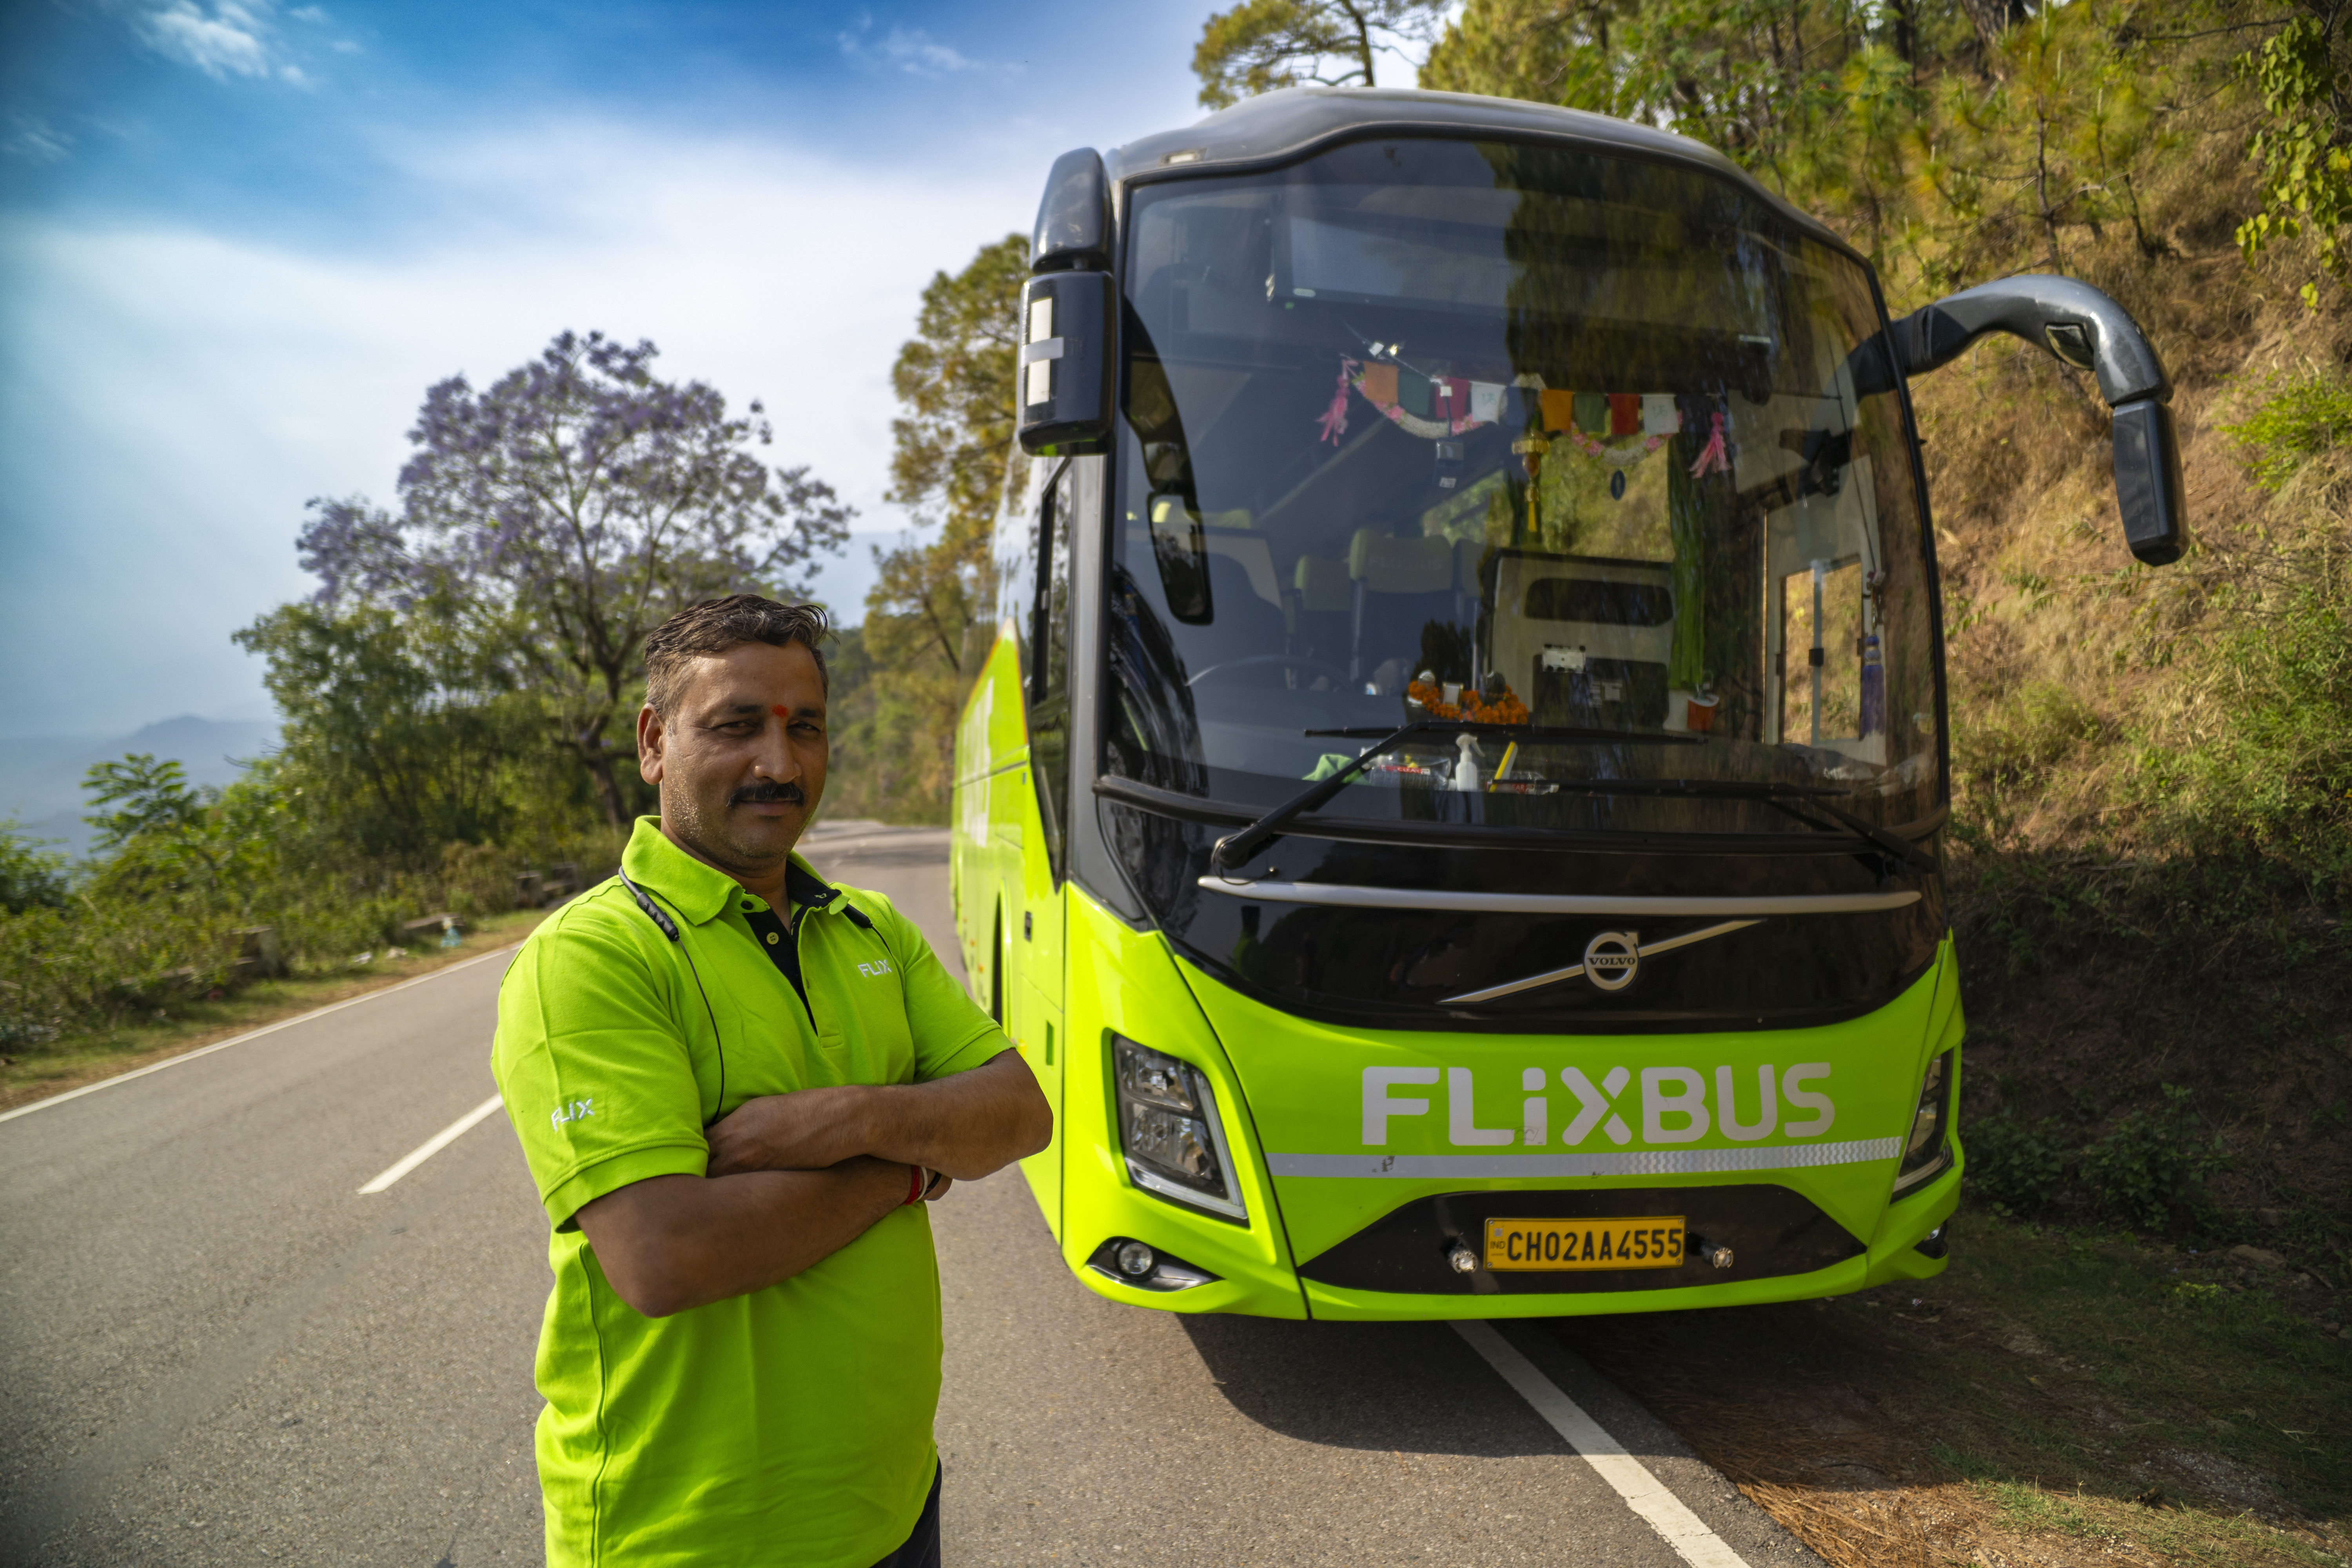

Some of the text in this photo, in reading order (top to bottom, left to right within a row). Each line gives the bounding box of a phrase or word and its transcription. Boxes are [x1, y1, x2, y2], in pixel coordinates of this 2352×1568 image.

[1587, 957, 1636, 965] VOLVO
[1490, 1241, 1505, 1249] IND
[1507, 1229, 1683, 1261] CH02AA4555
